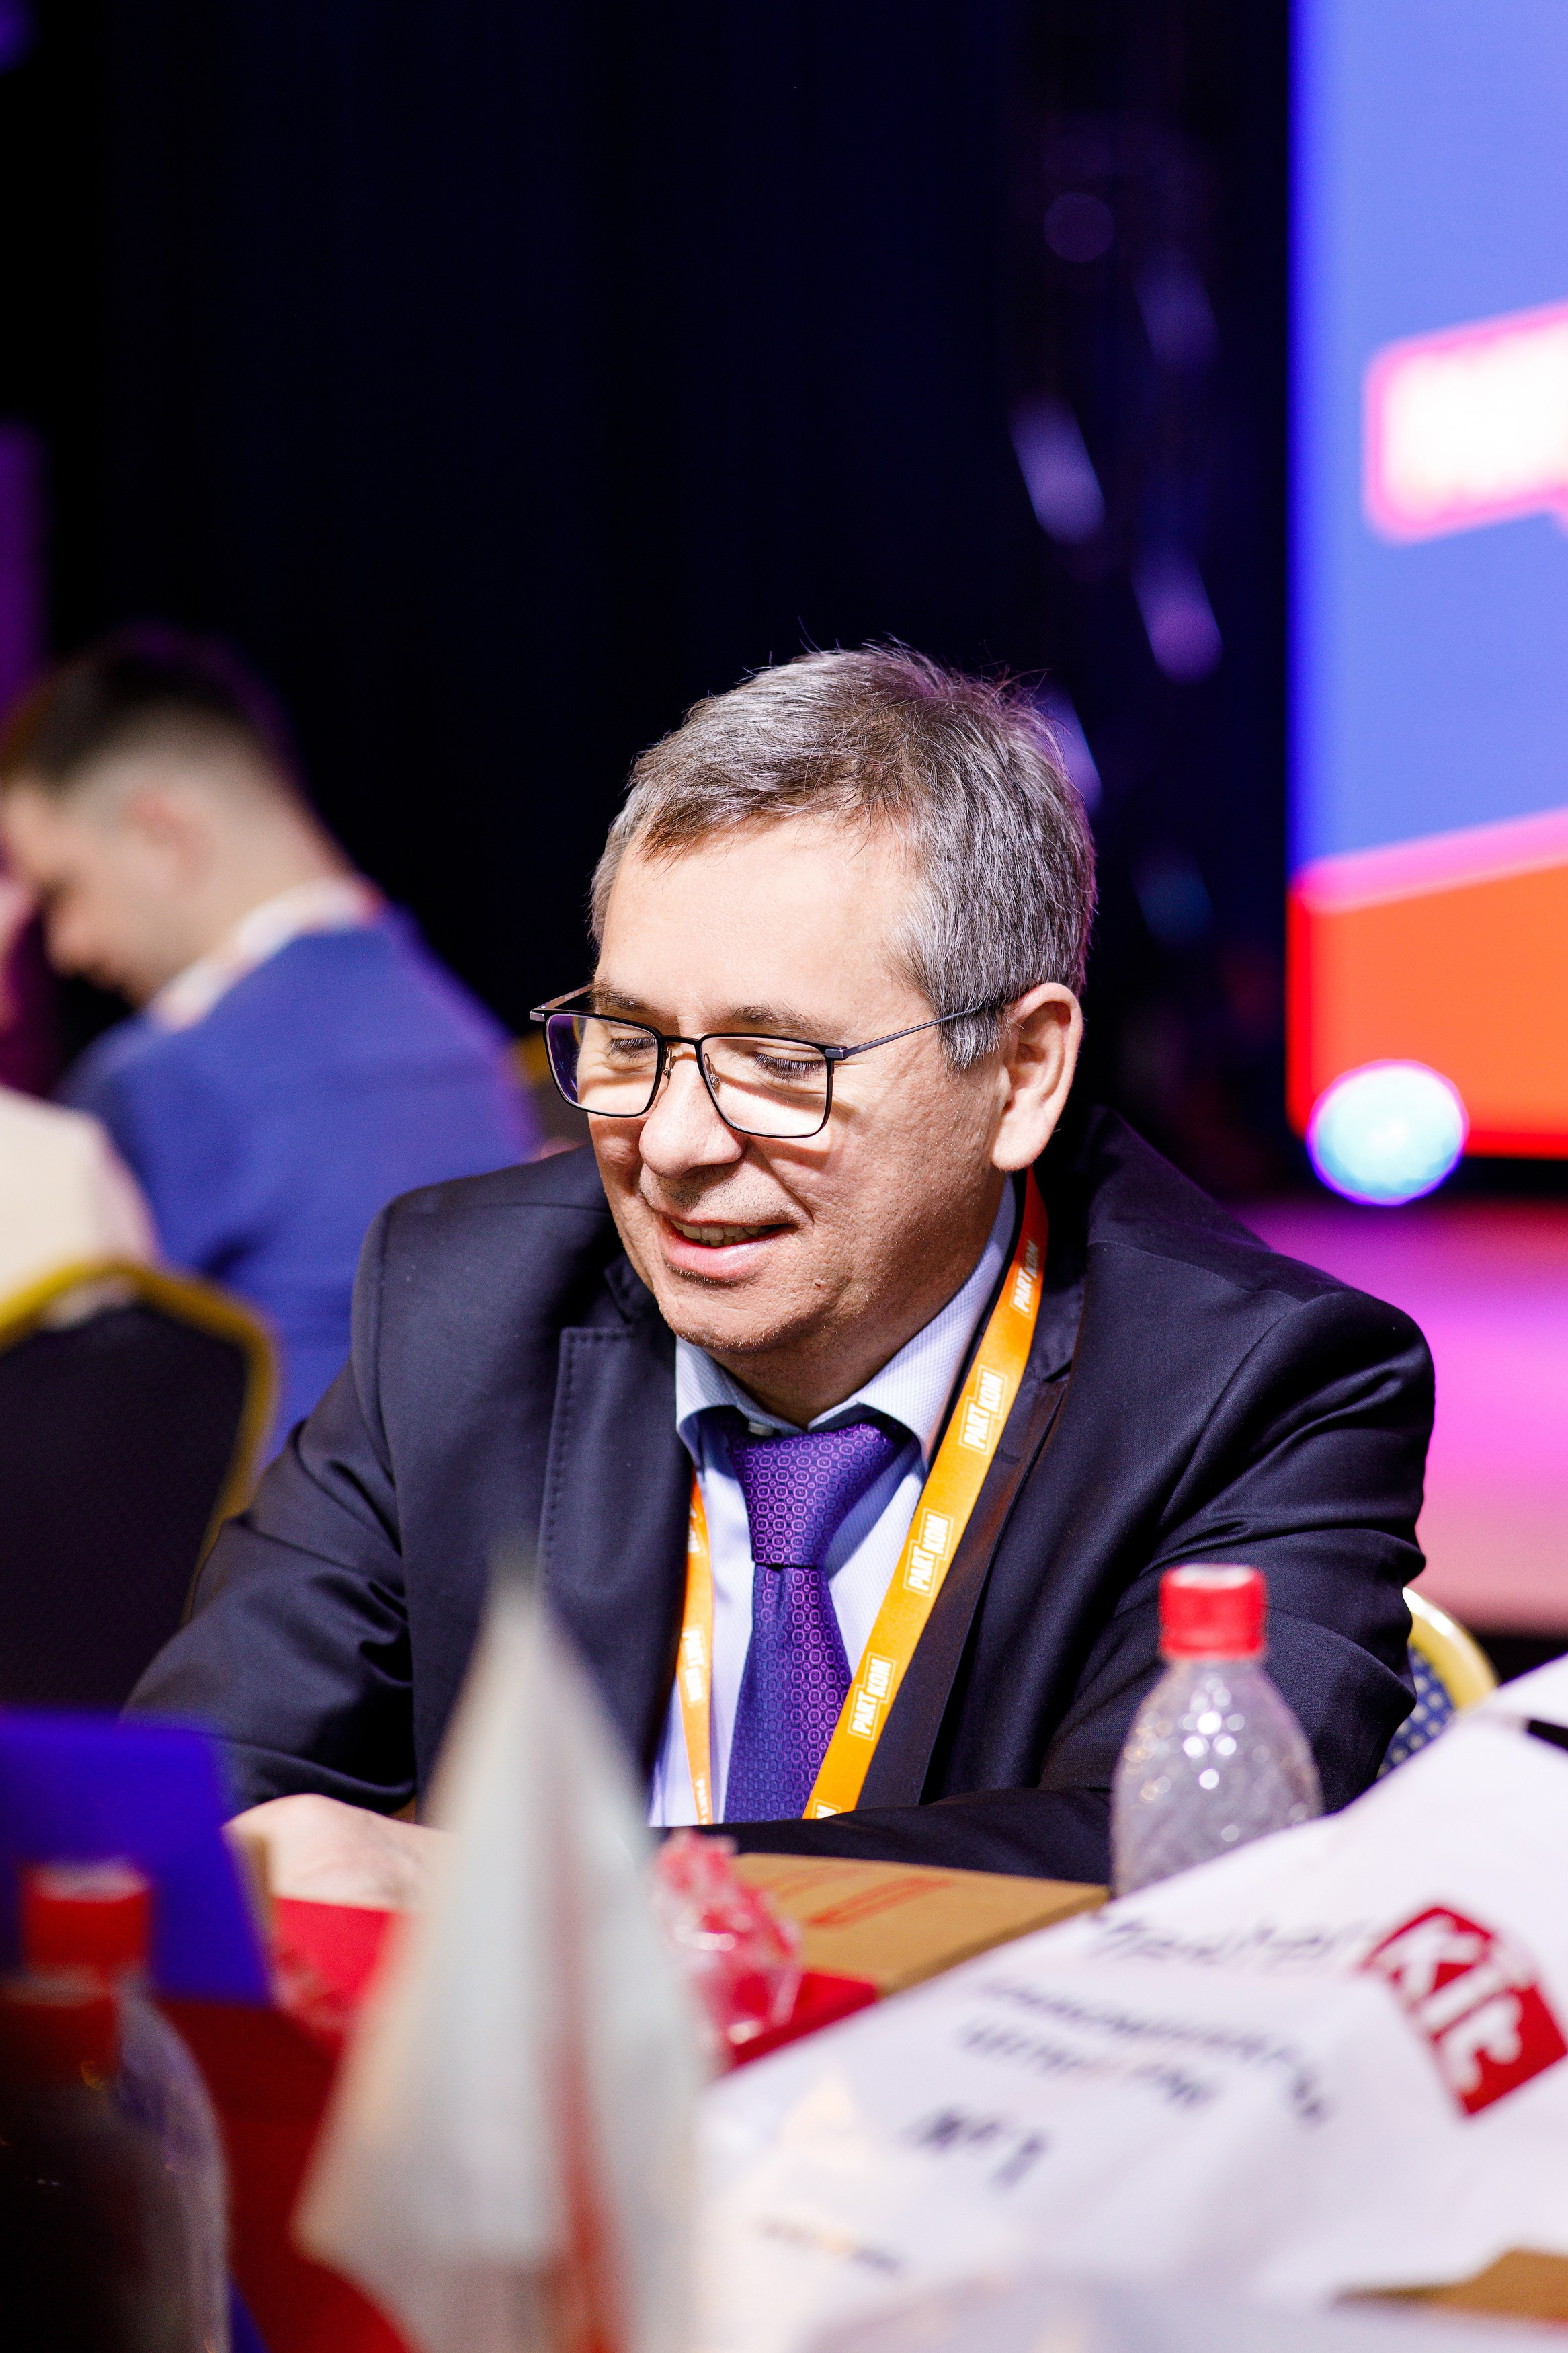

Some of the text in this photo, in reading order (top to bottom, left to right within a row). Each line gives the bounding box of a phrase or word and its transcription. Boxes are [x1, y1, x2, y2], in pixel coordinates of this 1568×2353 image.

[1013, 1267, 1032, 1313] PART
[964, 1371, 1003, 1449] PART KOM
[908, 1513, 948, 1591] PART KOM
[852, 1657, 891, 1735] PART KOM
